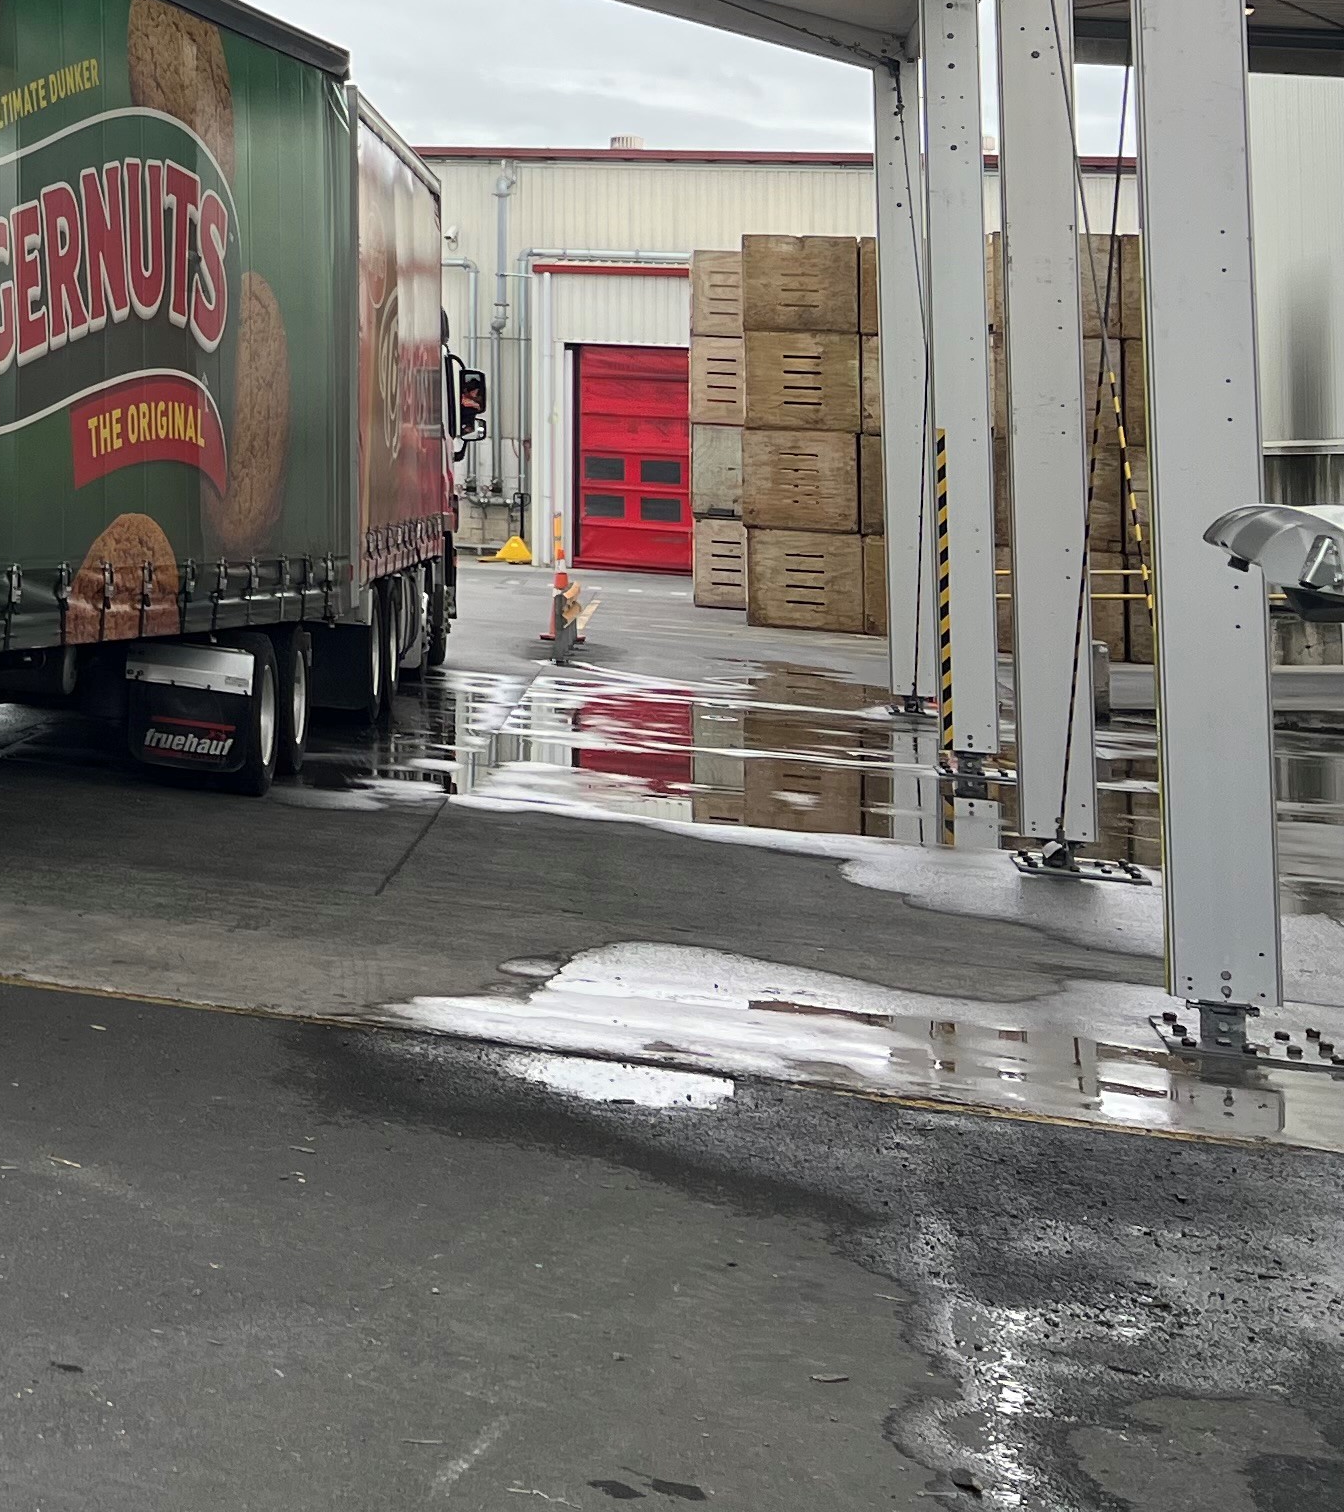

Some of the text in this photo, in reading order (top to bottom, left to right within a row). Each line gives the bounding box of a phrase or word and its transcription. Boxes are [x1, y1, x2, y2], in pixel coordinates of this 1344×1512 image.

[48, 58, 100, 104] DUNKER
[88, 400, 206, 458] THE ORIGINAL
[143, 727, 234, 756] fruehauf
